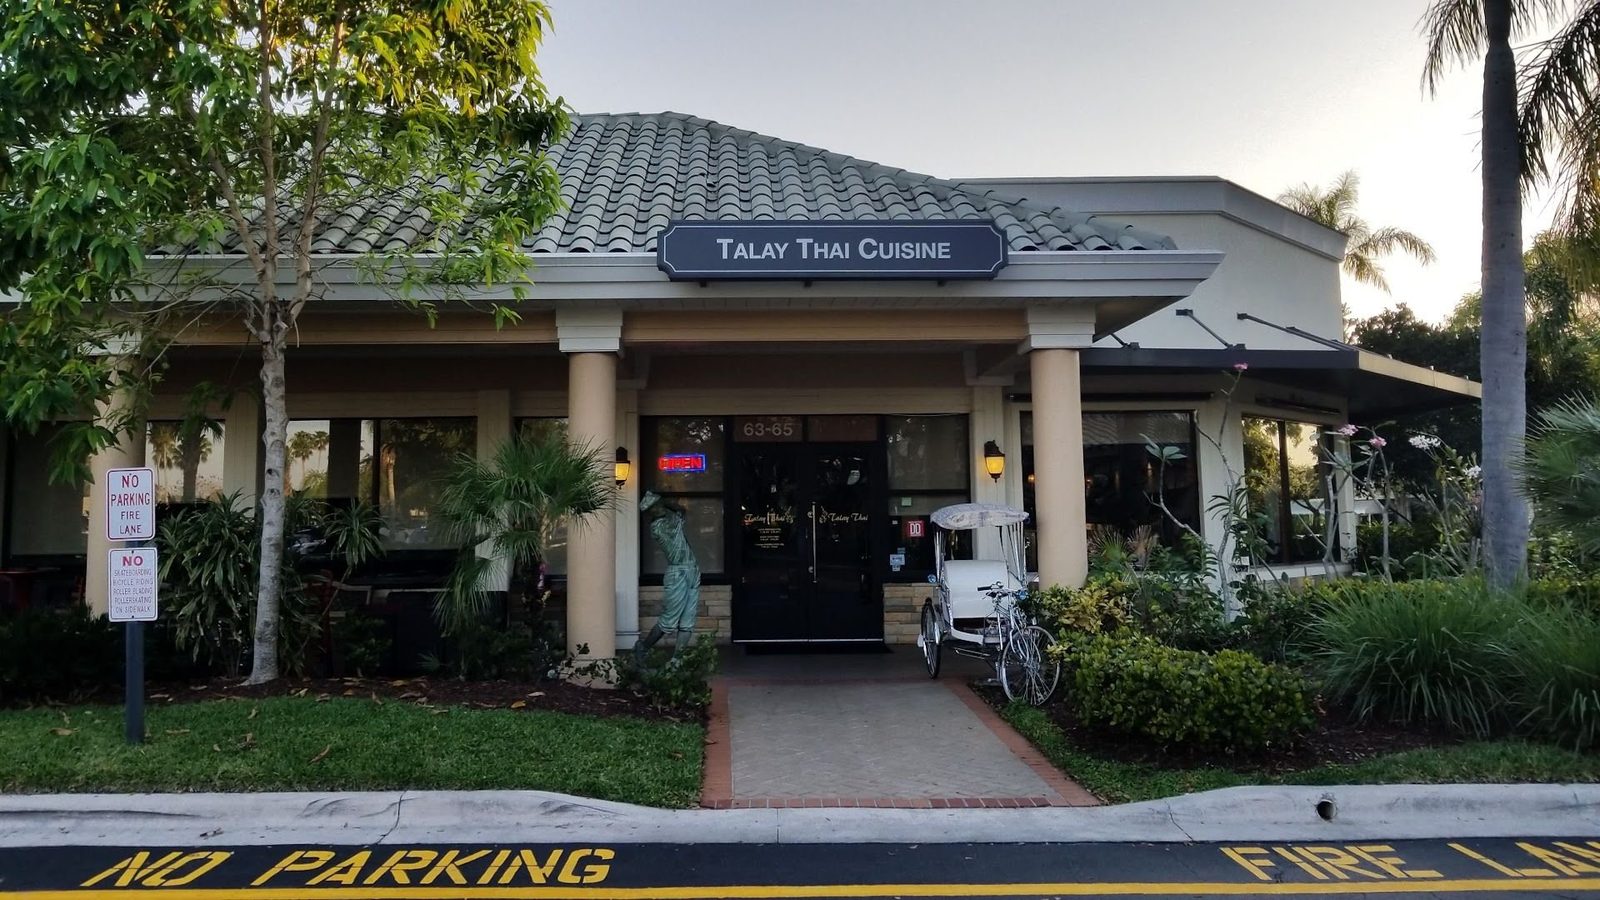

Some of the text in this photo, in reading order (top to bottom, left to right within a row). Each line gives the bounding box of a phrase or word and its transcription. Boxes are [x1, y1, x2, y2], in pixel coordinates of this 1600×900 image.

[716, 238, 951, 259] TALAY THAI CUISINE
[743, 422, 793, 437] 63-65
[658, 456, 703, 470] OPEN
[121, 474, 139, 489] NO
[111, 493, 151, 507] PARKING
[120, 510, 141, 520] FIRE
[119, 525, 142, 535] LANE
[122, 555, 144, 567] NO
[114, 568, 152, 577] SKATEBOARDING
[80, 848, 616, 887] NO PARKING
[1219, 844, 1444, 881] FIRE
